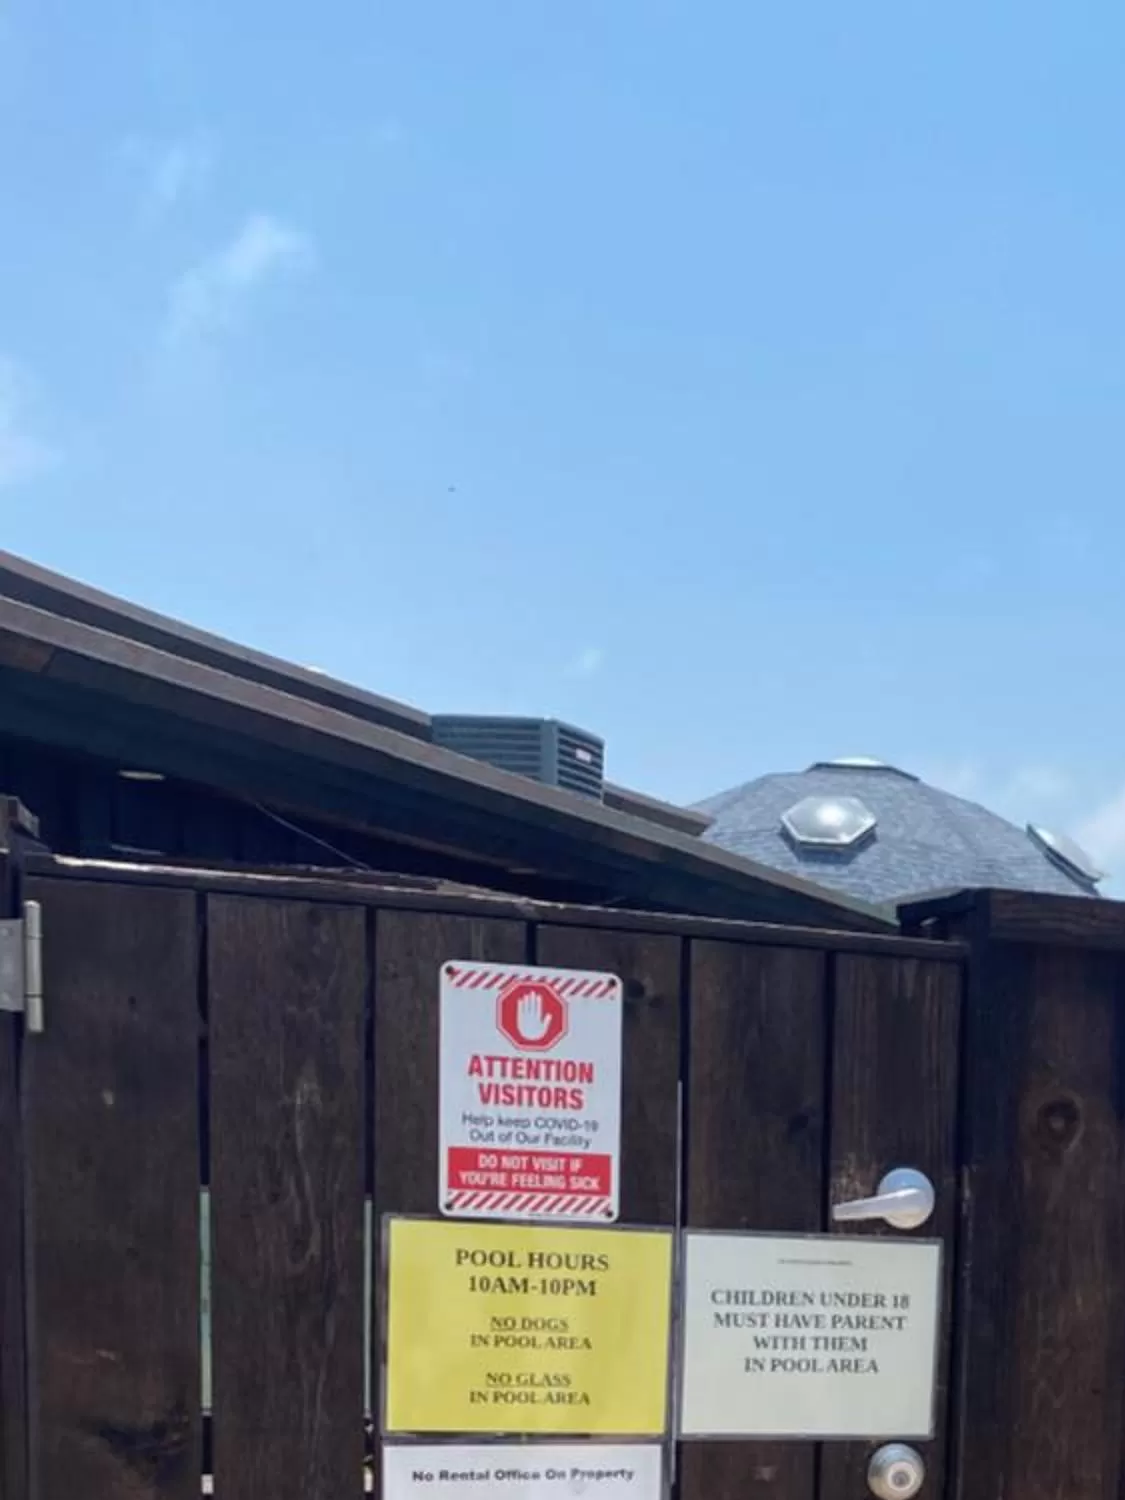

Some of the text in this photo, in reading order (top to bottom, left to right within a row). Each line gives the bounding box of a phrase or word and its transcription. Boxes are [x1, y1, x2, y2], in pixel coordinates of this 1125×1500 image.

[468, 1055, 594, 1083] ATTENTION
[478, 1083, 584, 1110] VISITORS
[461, 1113, 599, 1132] Help keep COVID-19
[469, 1129, 591, 1149] Out of Our Facility
[478, 1153, 583, 1172] DO NOT VISIT IF
[511, 1173, 566, 1189] FEELING
[569, 1175, 600, 1191] SICK
[455, 1248, 610, 1271] POOL HOURS
[468, 1275, 597, 1297] 10AM-10PM
[710, 1289, 910, 1309] CHILDREN UNDER 18
[490, 1316, 570, 1331] NO DOGS
[713, 1312, 908, 1330] MUST HAVE PARENT
[470, 1335, 592, 1350] IN POOL AREA
[753, 1335, 868, 1352] WITH THEM
[744, 1357, 879, 1374] IN POOL AREA
[486, 1372, 572, 1387] NO GLASS
[469, 1391, 591, 1406] IN POOL AREA
[412, 1468, 635, 1482] No Rental Office On Property
